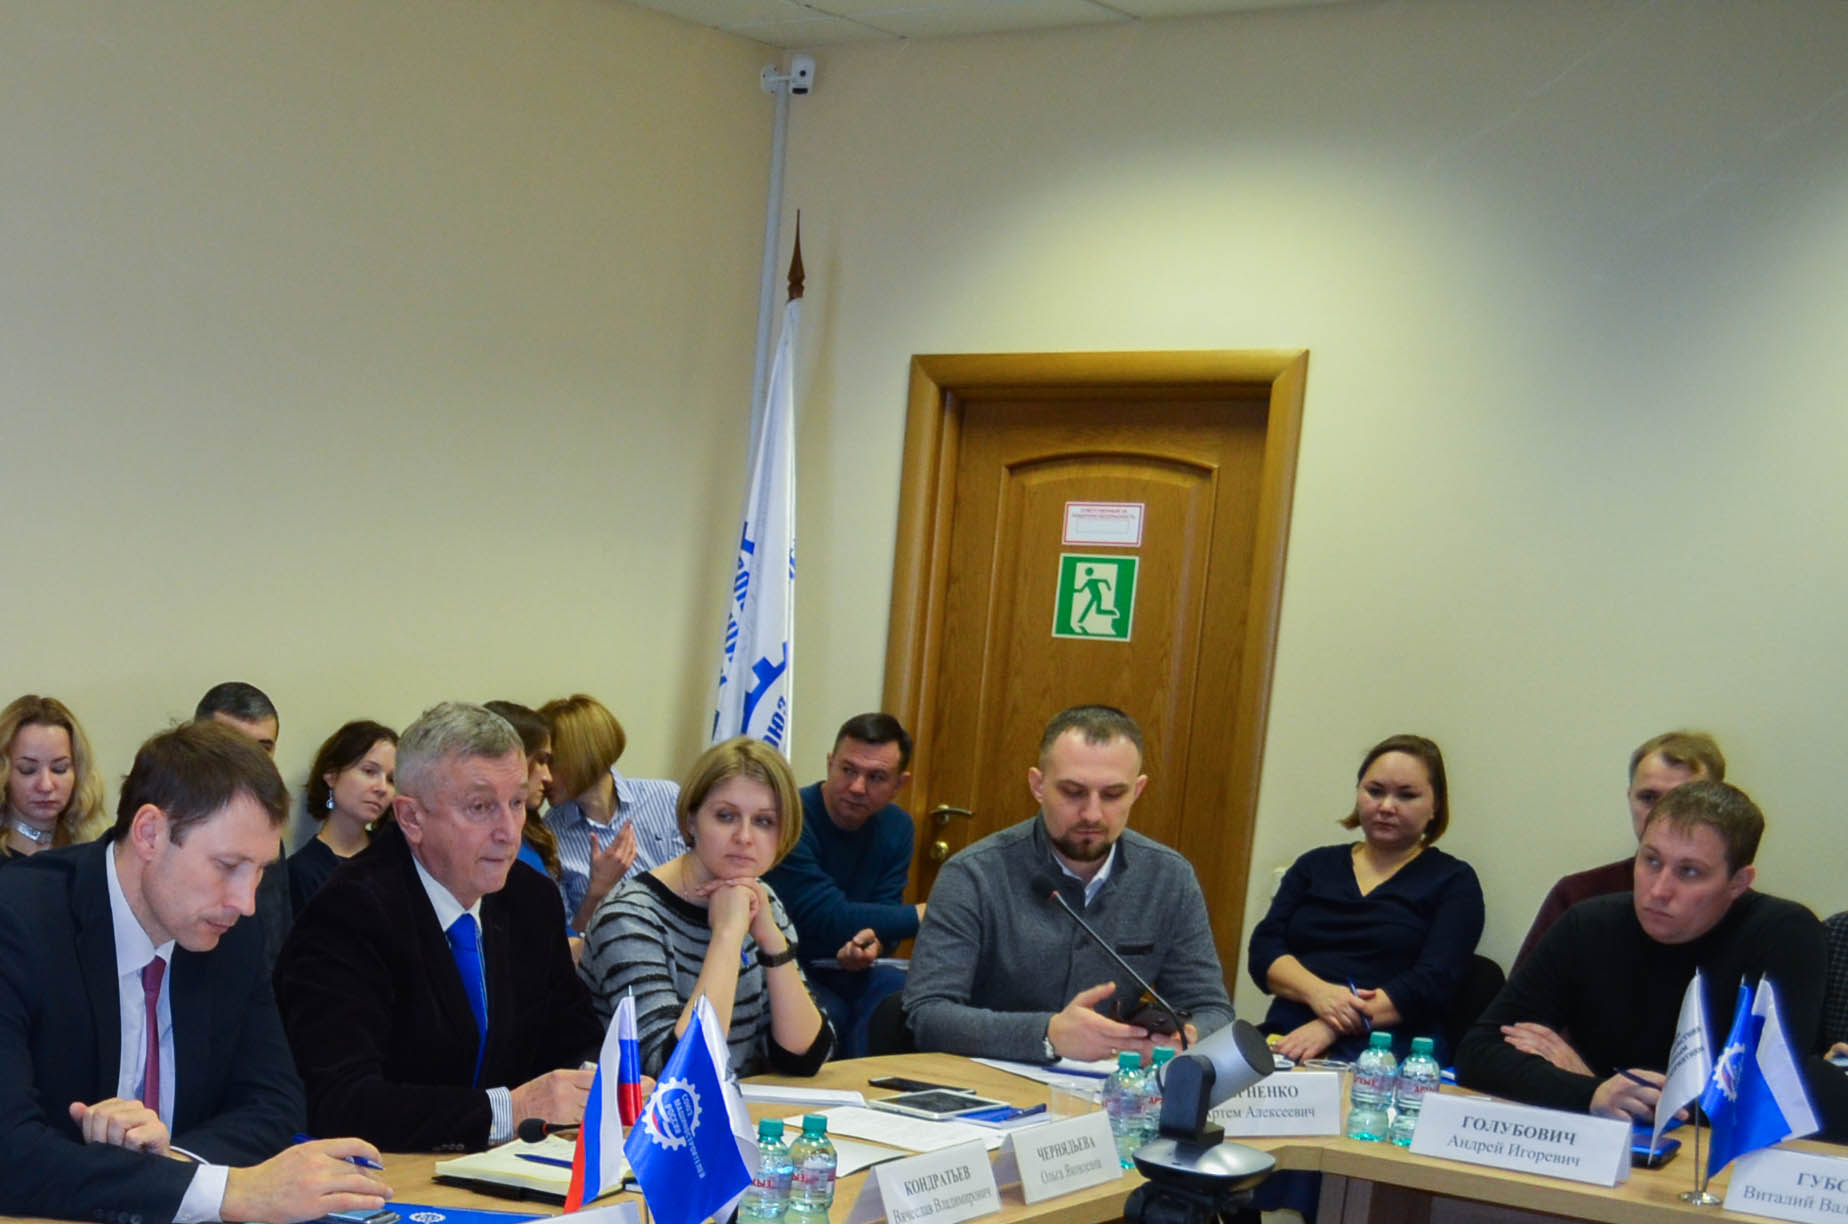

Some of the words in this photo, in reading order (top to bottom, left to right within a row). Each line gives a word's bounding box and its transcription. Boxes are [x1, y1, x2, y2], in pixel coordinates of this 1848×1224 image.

[1461, 1114, 1577, 1146] ГОЛУБОВИЧ
[1447, 1134, 1503, 1156] Андрей
[1507, 1142, 1581, 1168] Игоревич
[903, 1165, 972, 1197] КОНДРАТЬЕВ
